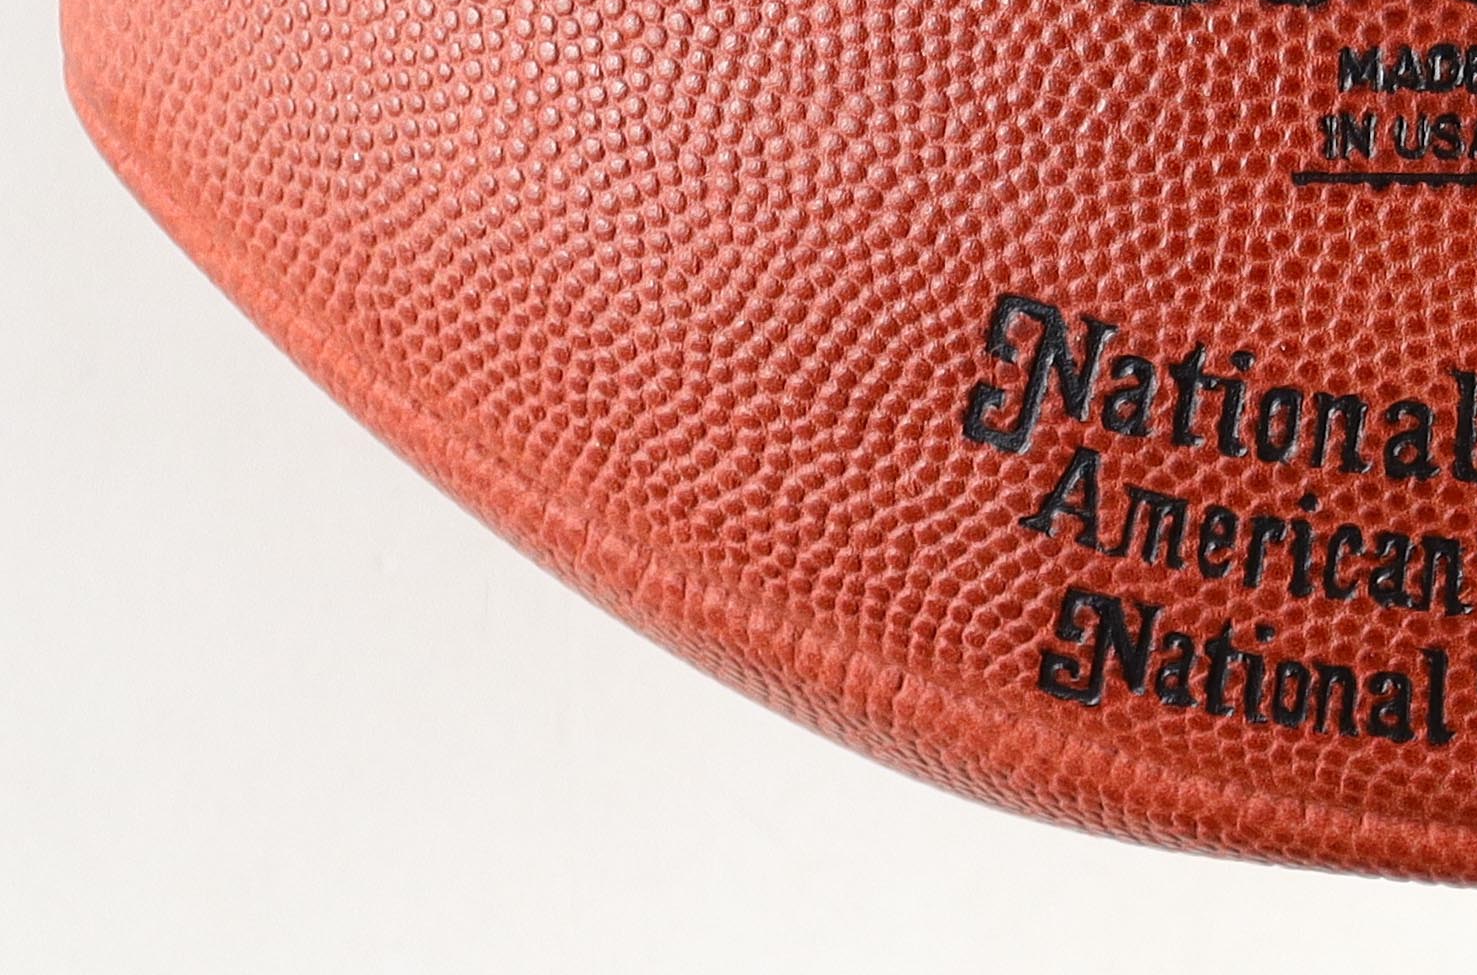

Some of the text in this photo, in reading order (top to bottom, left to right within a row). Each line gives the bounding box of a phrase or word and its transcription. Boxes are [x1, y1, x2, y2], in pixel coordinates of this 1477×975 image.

[1322, 111, 1379, 160] IN
[1017, 444, 1474, 616] American
[1036, 586, 1457, 748] National
